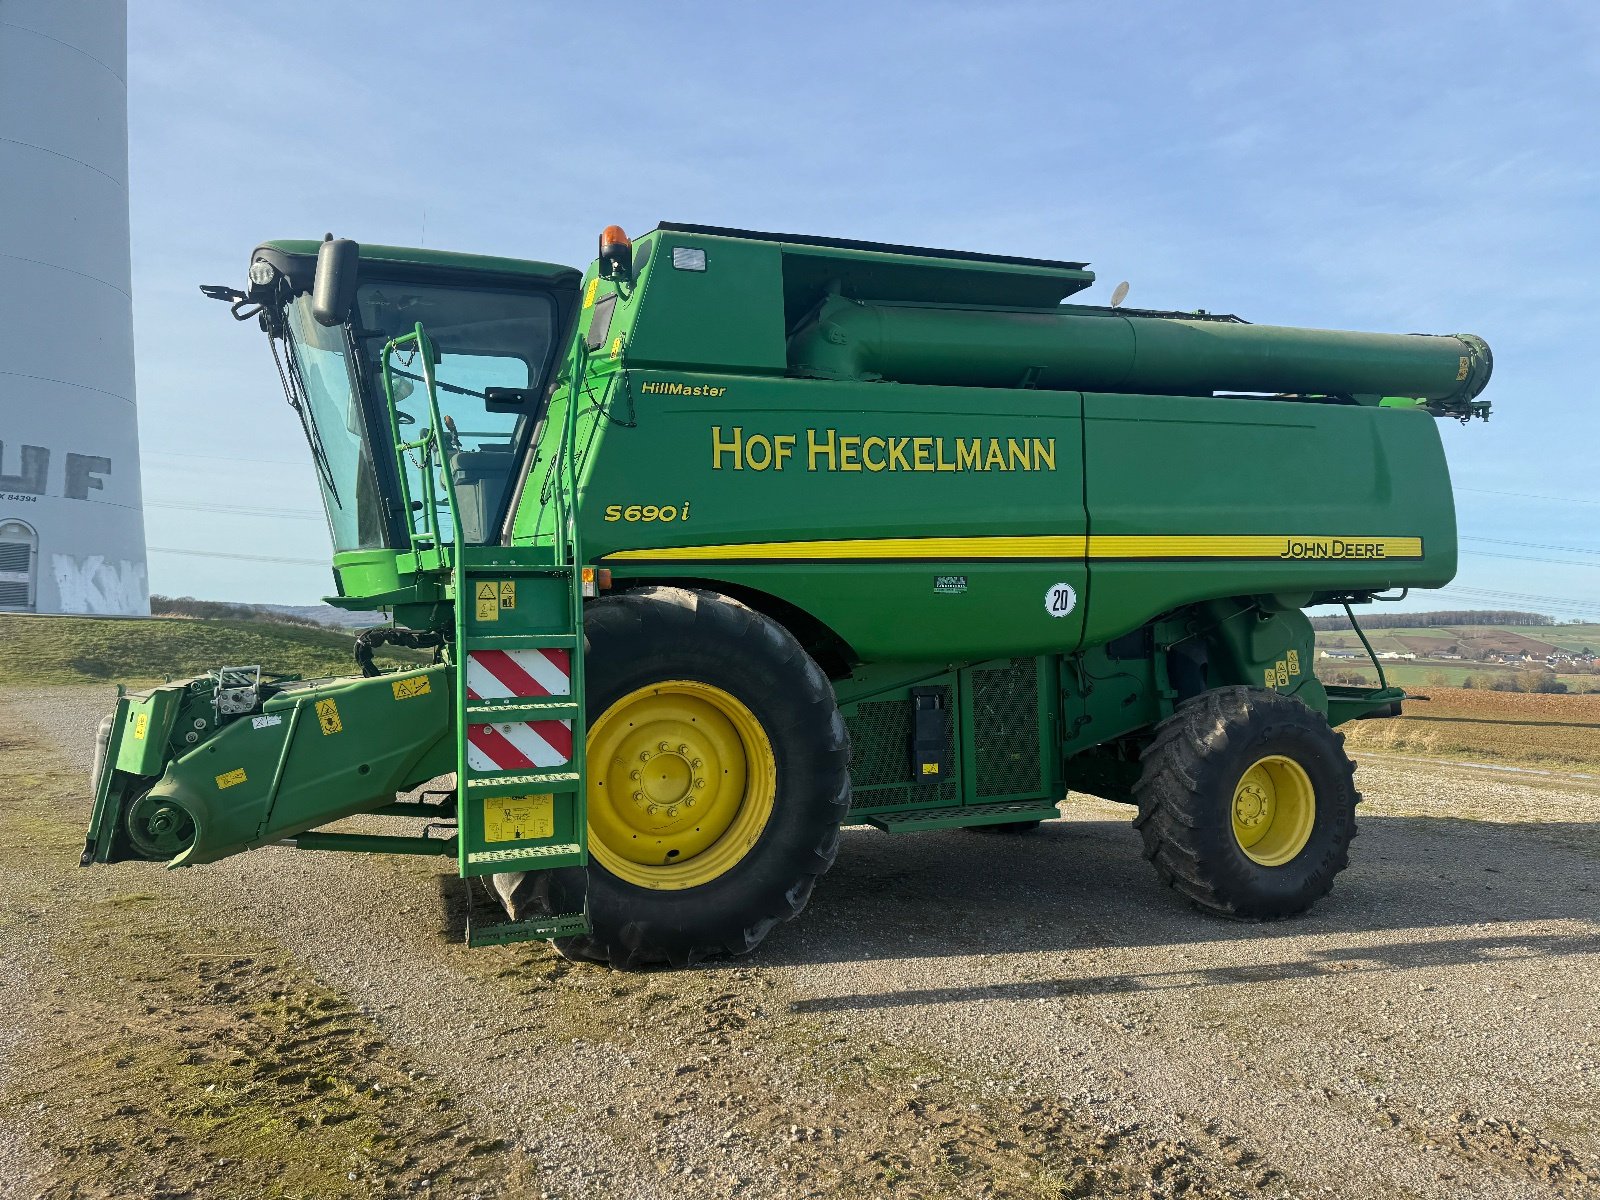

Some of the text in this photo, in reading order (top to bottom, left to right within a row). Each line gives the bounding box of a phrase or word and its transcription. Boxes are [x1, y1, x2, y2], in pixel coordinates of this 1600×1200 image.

[641, 381, 727, 397] HillMaster
[711, 425, 1057, 473] HOF HECKELMANN
[7, 494, 37, 503] 84394
[1281, 539, 1385, 557] JOHN DEERE
[1052, 589, 1069, 612] 20
